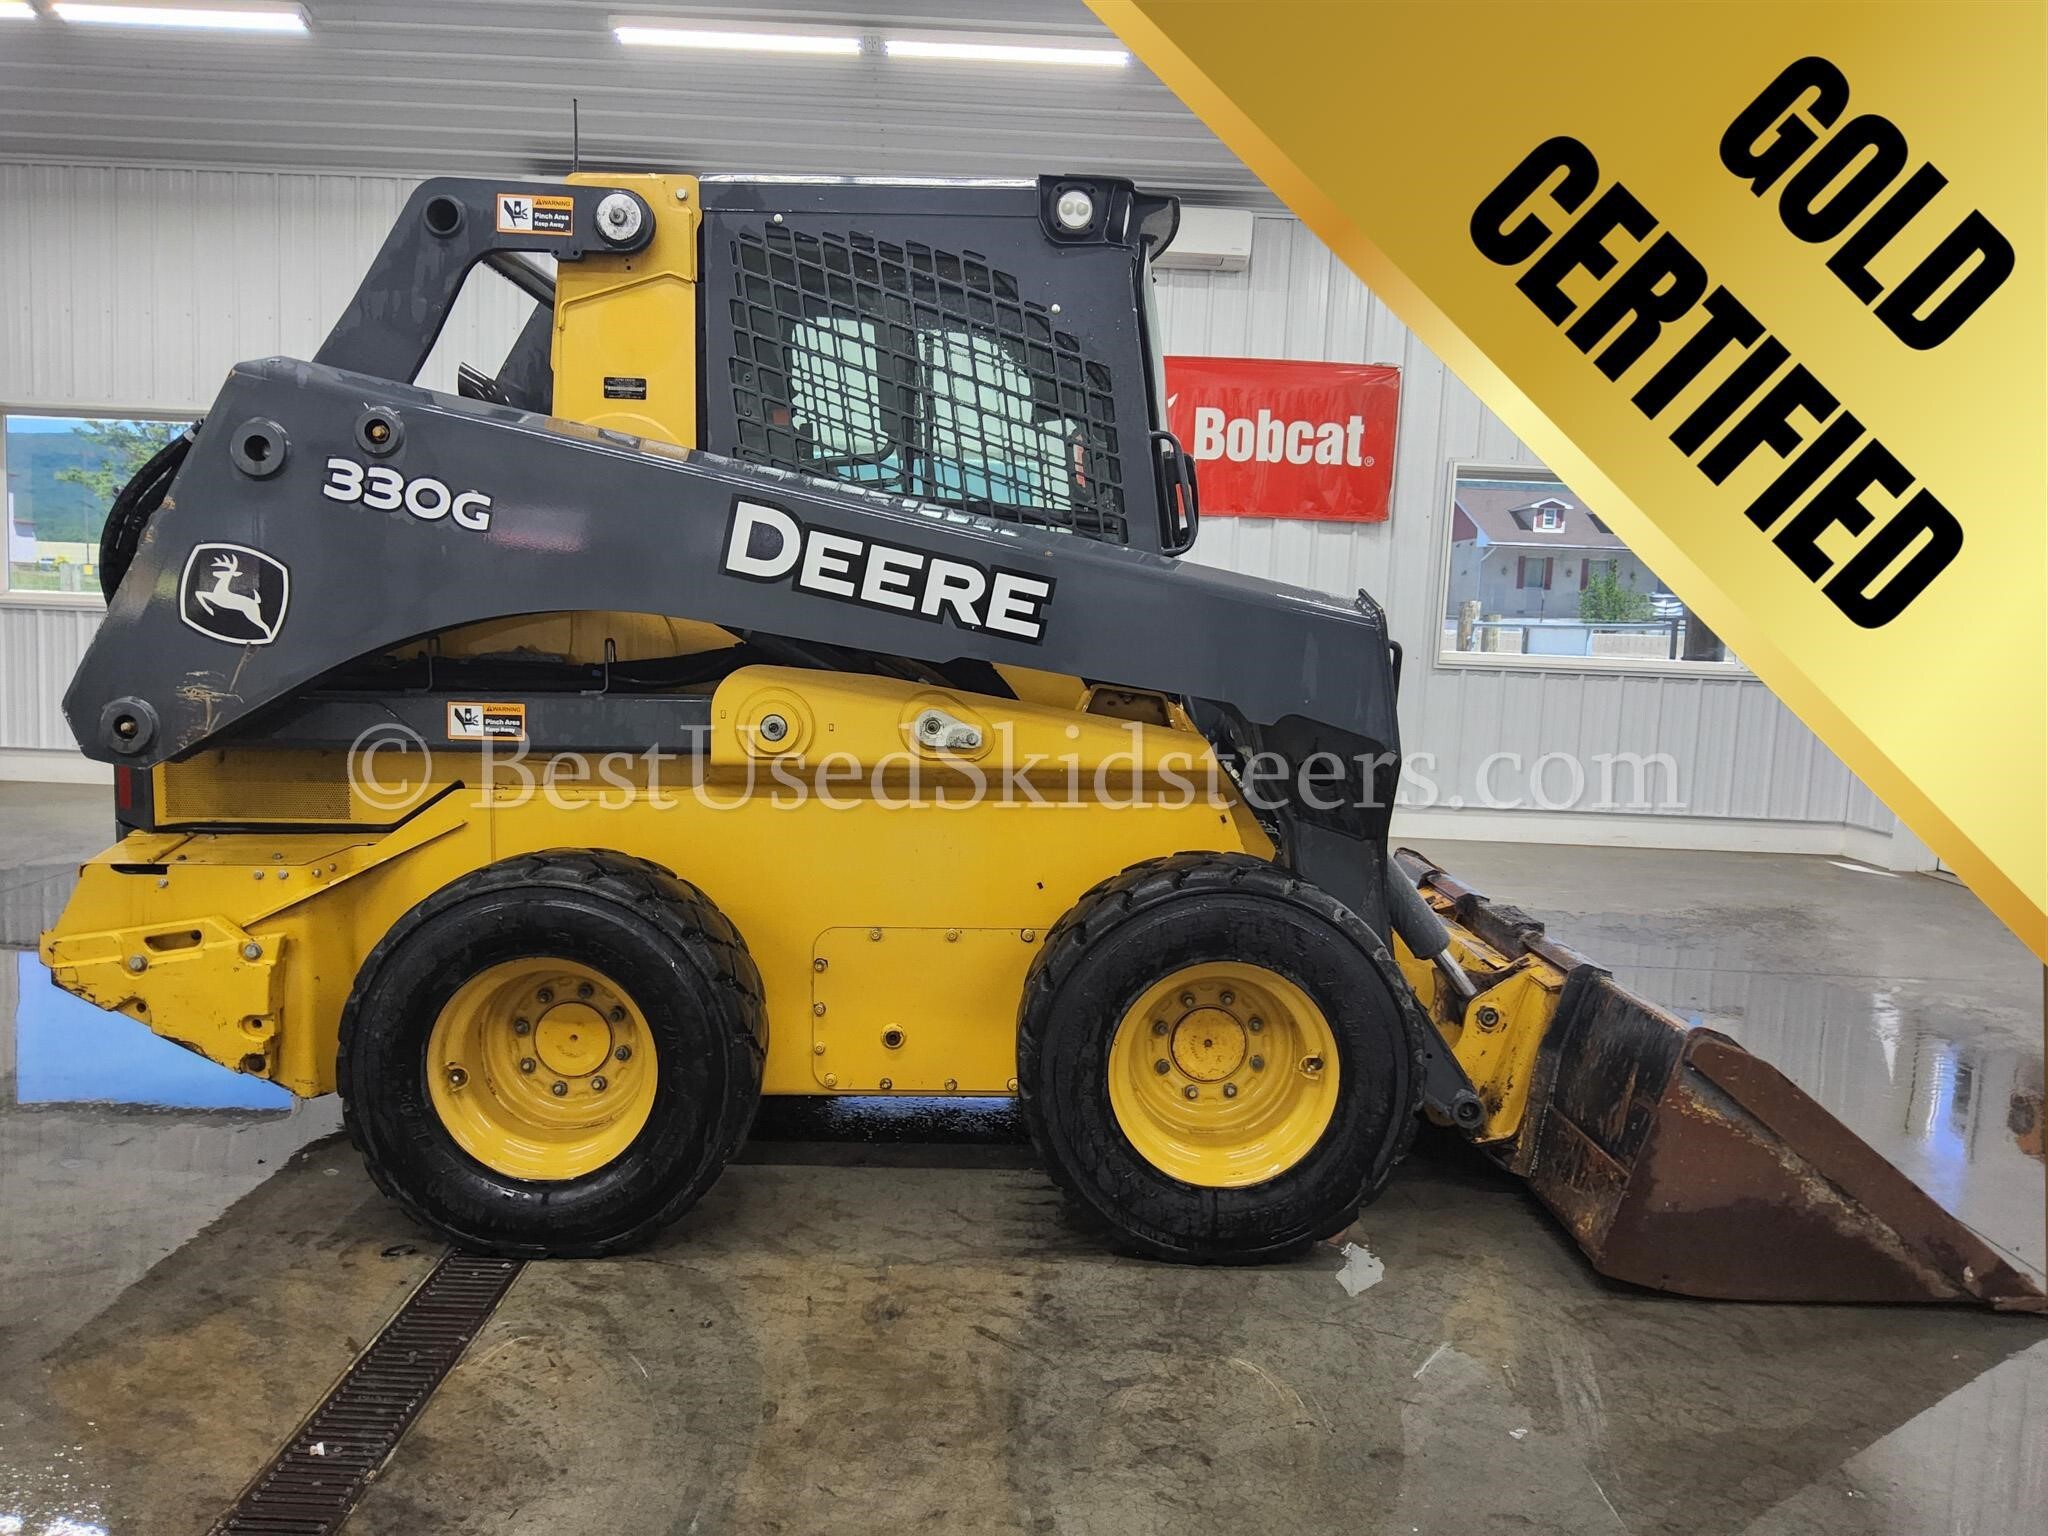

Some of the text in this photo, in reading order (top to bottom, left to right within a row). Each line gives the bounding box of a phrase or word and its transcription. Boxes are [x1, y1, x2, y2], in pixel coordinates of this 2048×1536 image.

[534, 212, 570, 221] Pinch Area
[1194, 407, 1365, 467] Bobcat
[323, 458, 492, 531] 330G
[726, 501, 1050, 638] DEERE
[485, 718, 504, 726] Pinch
